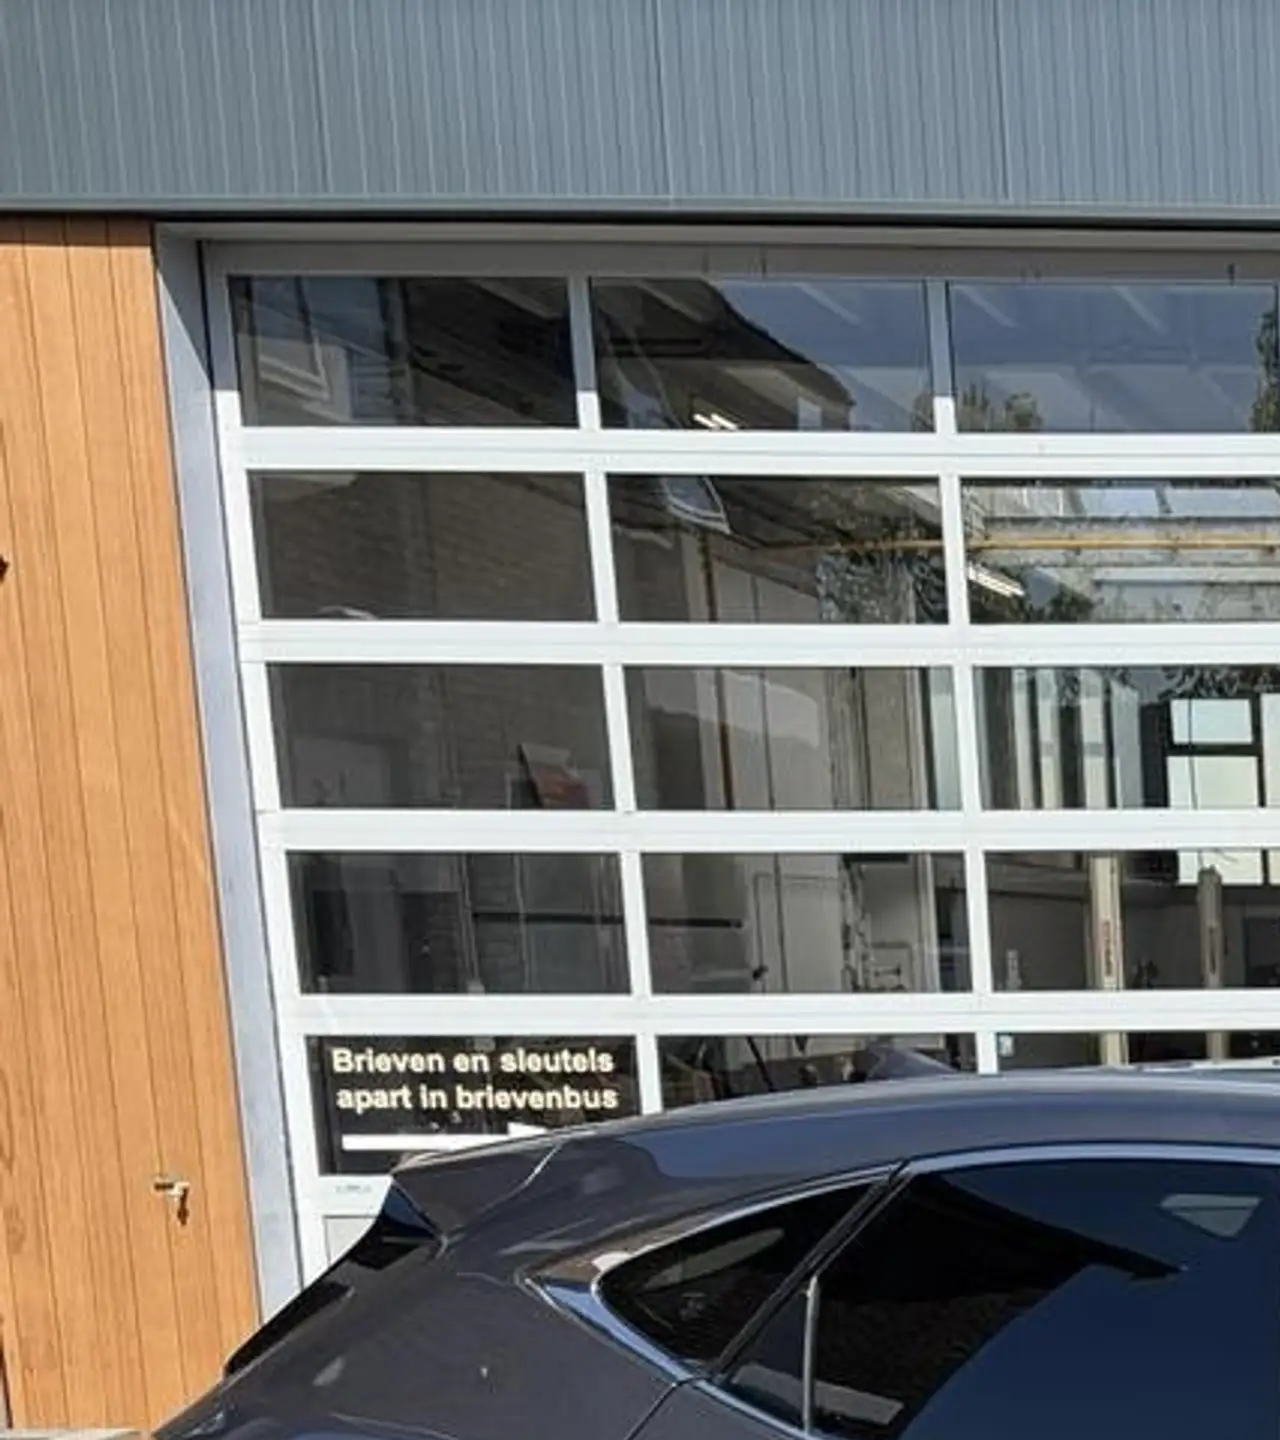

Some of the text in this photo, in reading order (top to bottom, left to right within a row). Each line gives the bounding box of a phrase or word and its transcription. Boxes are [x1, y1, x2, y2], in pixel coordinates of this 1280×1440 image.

[331, 1048, 615, 1073] Brieven en sleutels
[336, 1085, 619, 1114] apart in brievenbus
